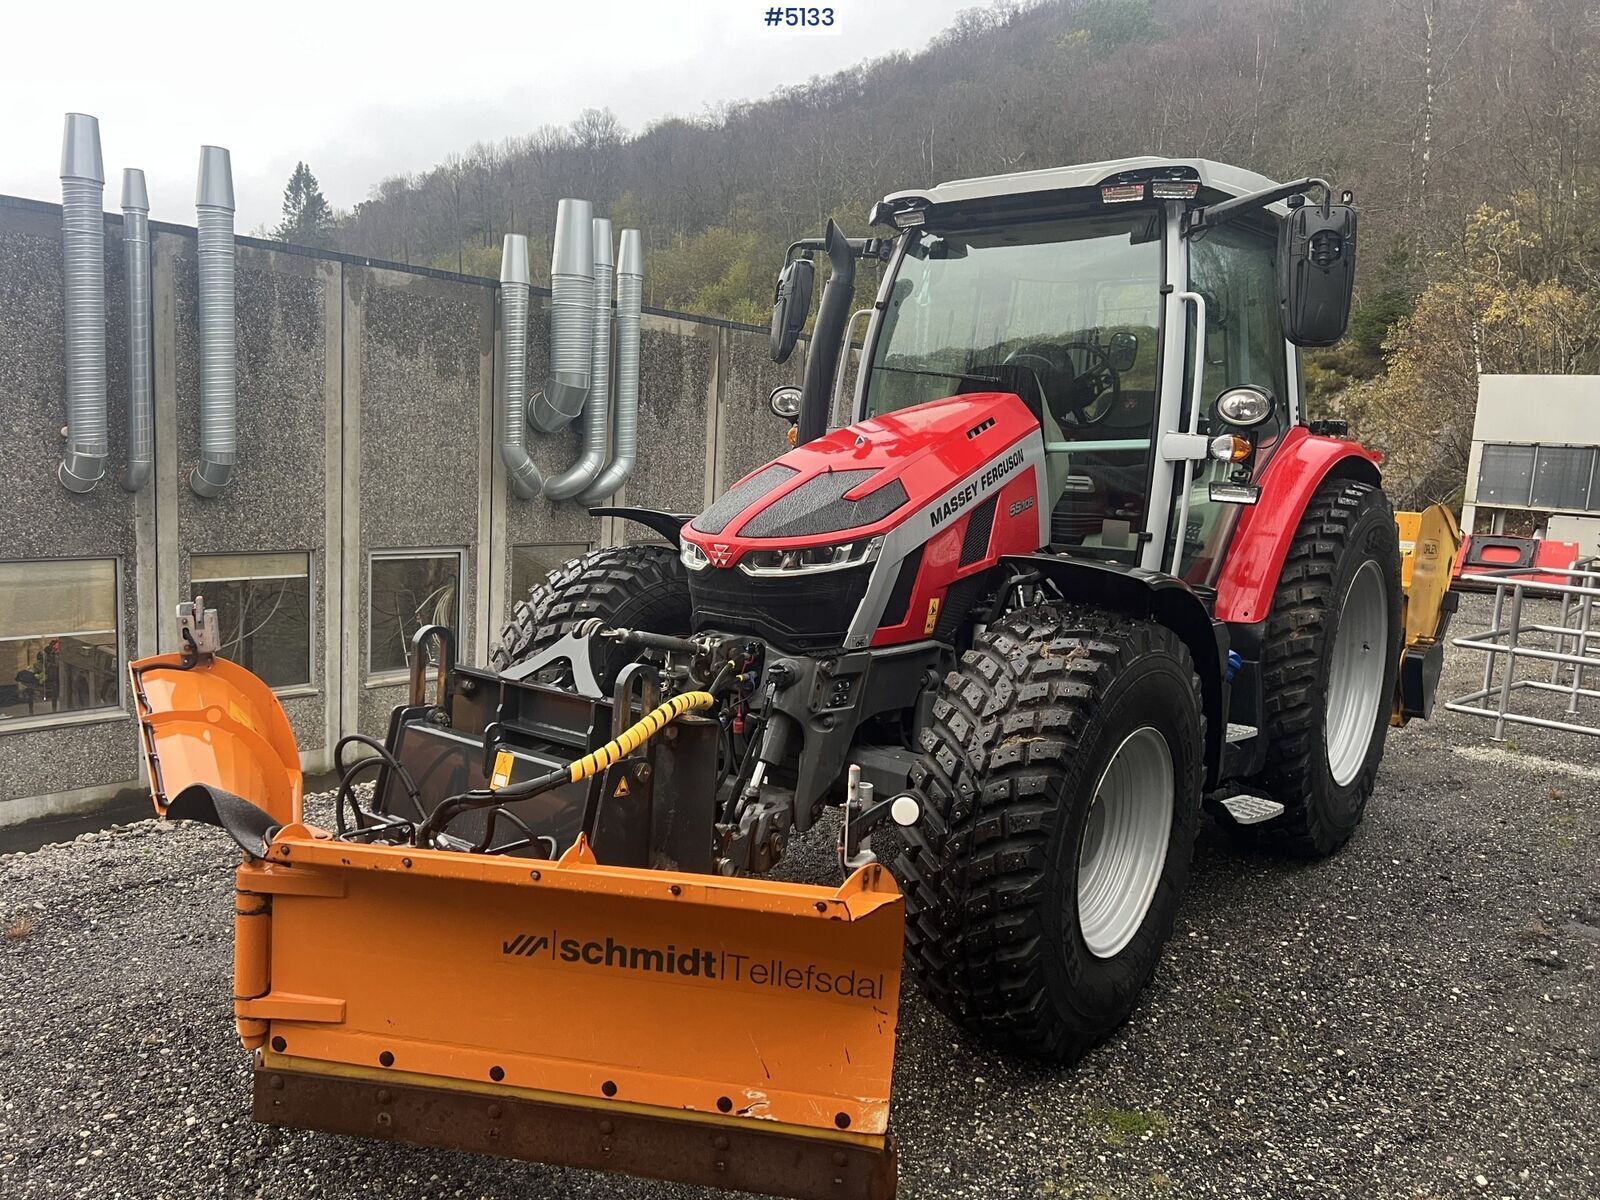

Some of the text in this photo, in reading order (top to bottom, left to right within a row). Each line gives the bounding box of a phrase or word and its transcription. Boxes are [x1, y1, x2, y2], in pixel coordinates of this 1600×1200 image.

[929, 448, 1025, 528] MASSEY FERGUSON
[560, 937, 884, 1000] schmidt Tellefsdal
